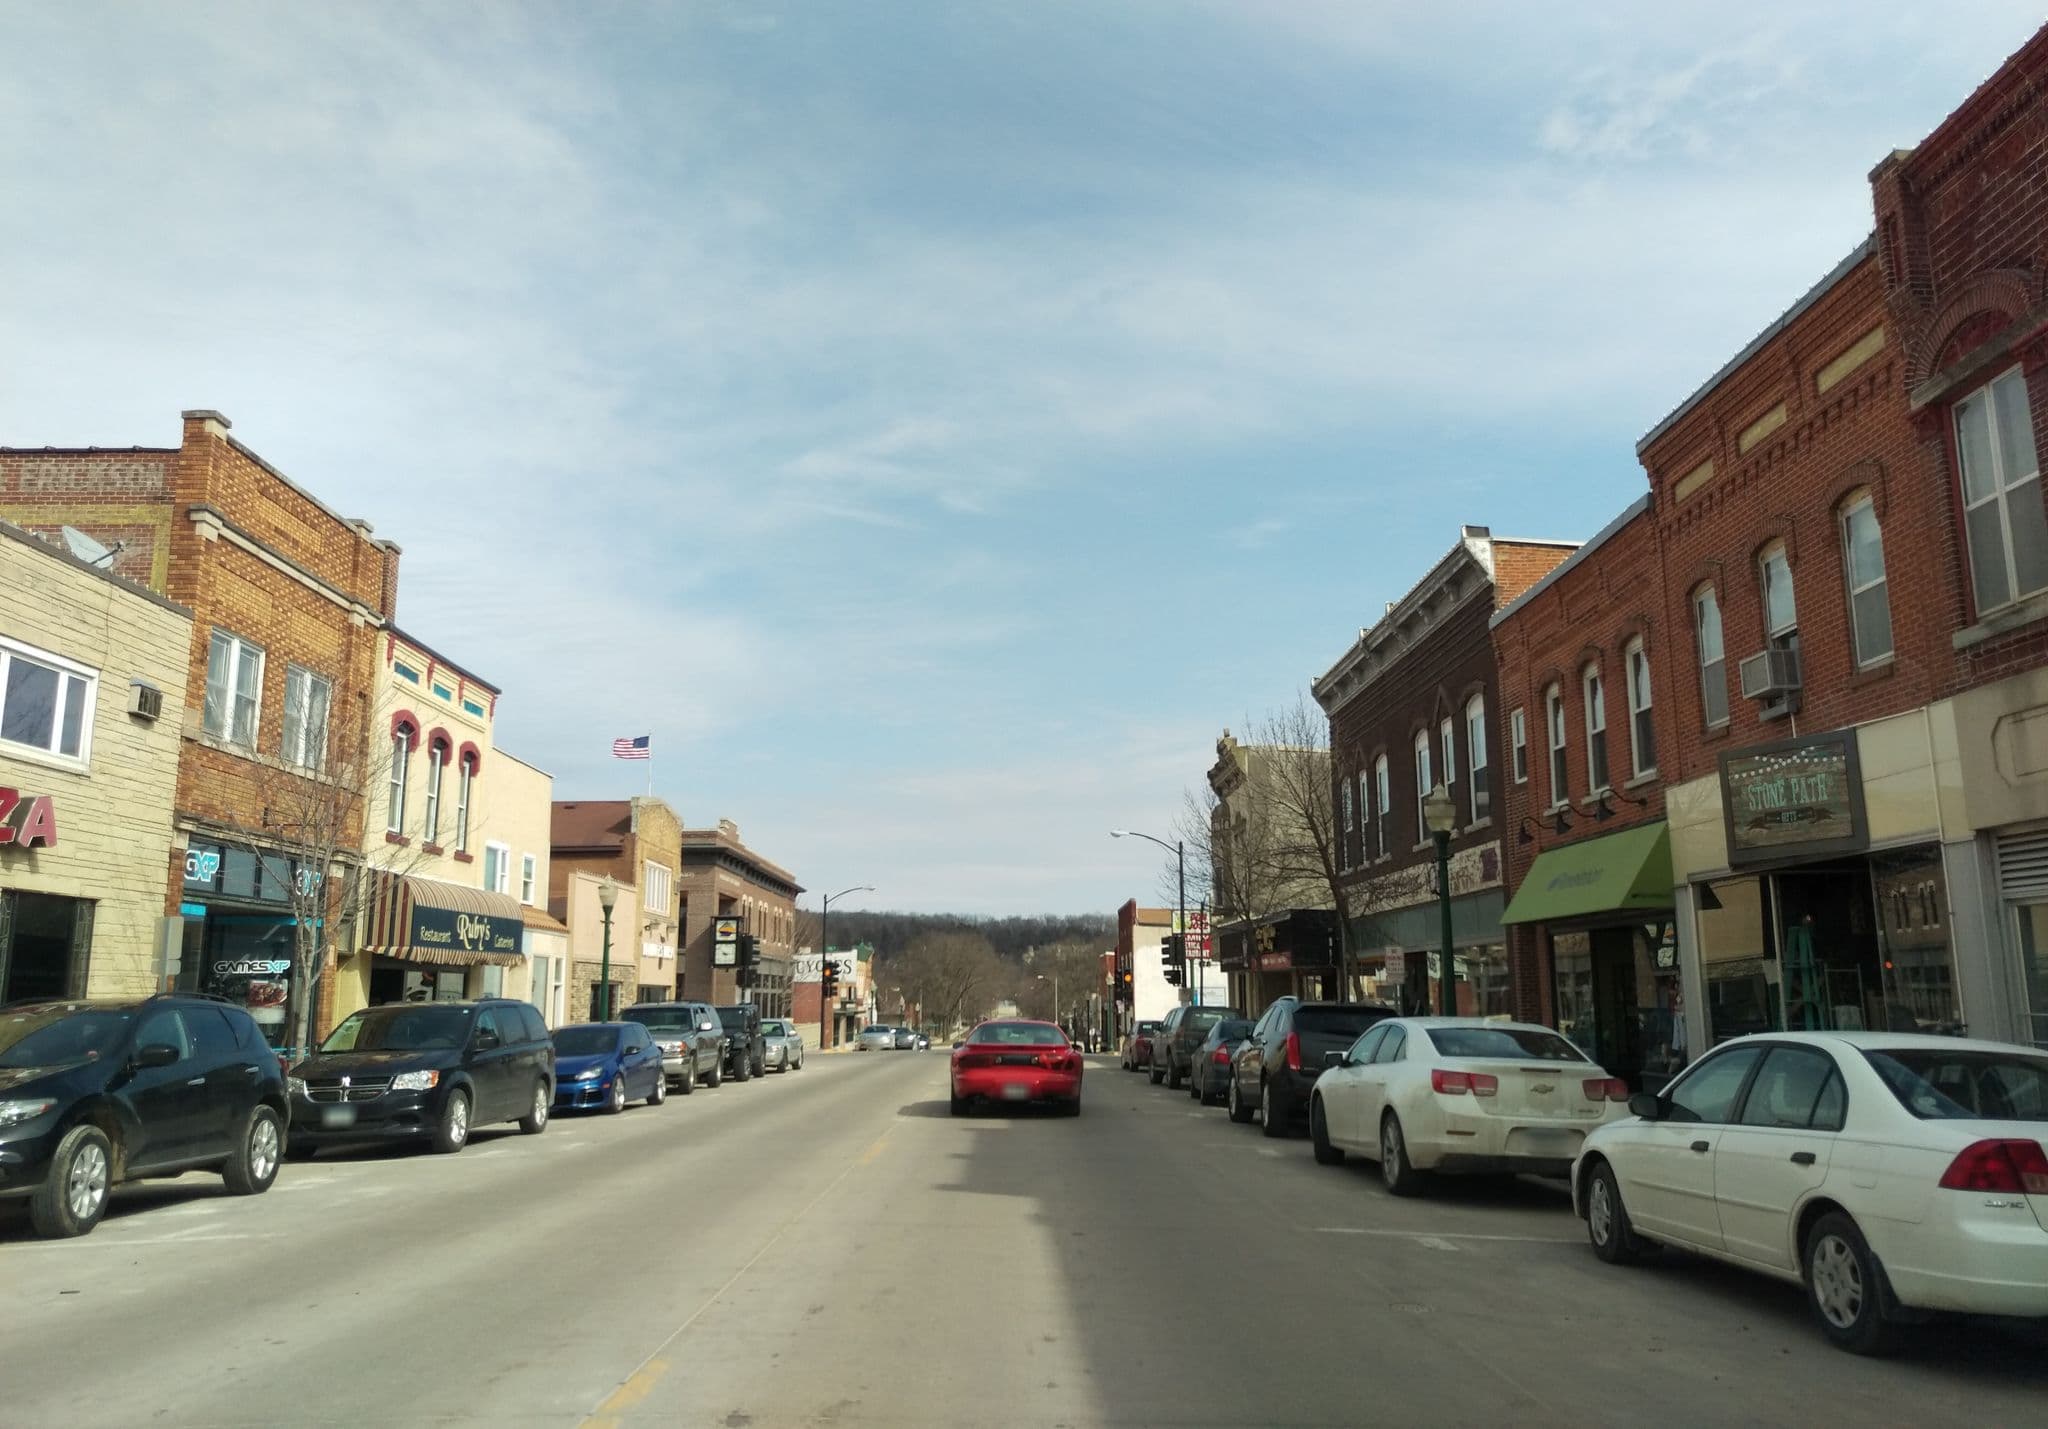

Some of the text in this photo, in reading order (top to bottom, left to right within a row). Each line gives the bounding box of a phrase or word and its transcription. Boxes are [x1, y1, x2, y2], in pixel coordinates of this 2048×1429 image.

[1748, 773, 1828, 811] STONE PATH
[184, 850, 220, 882] GXP
[421, 926, 451, 943] Restaurant
[457, 914, 491, 950] Ruby's
[213, 960, 291, 974] GAMESXP
